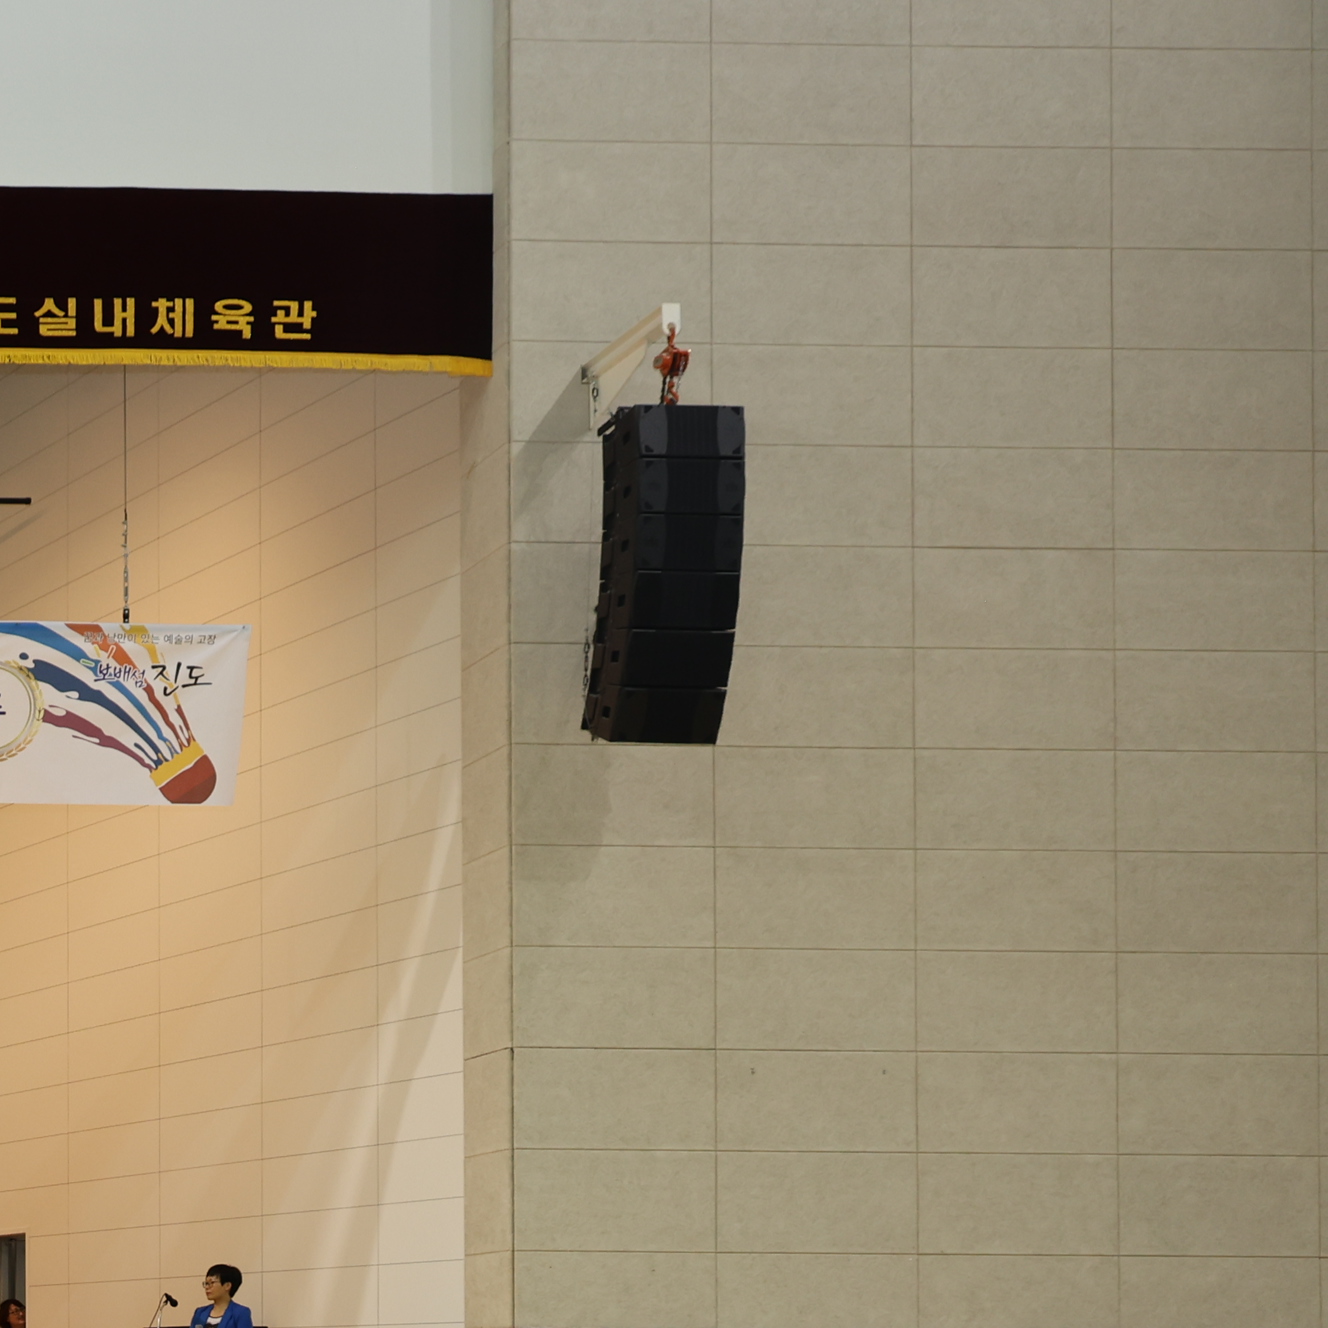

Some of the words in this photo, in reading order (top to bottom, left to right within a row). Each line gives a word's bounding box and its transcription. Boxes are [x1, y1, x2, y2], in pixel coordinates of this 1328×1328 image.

[140, 633, 161, 645] 있는
[163, 634, 194, 645] 예술의
[197, 634, 217, 646] 고장
[94, 662, 146, 689] 보배섬
[151, 661, 212, 697] 진도
